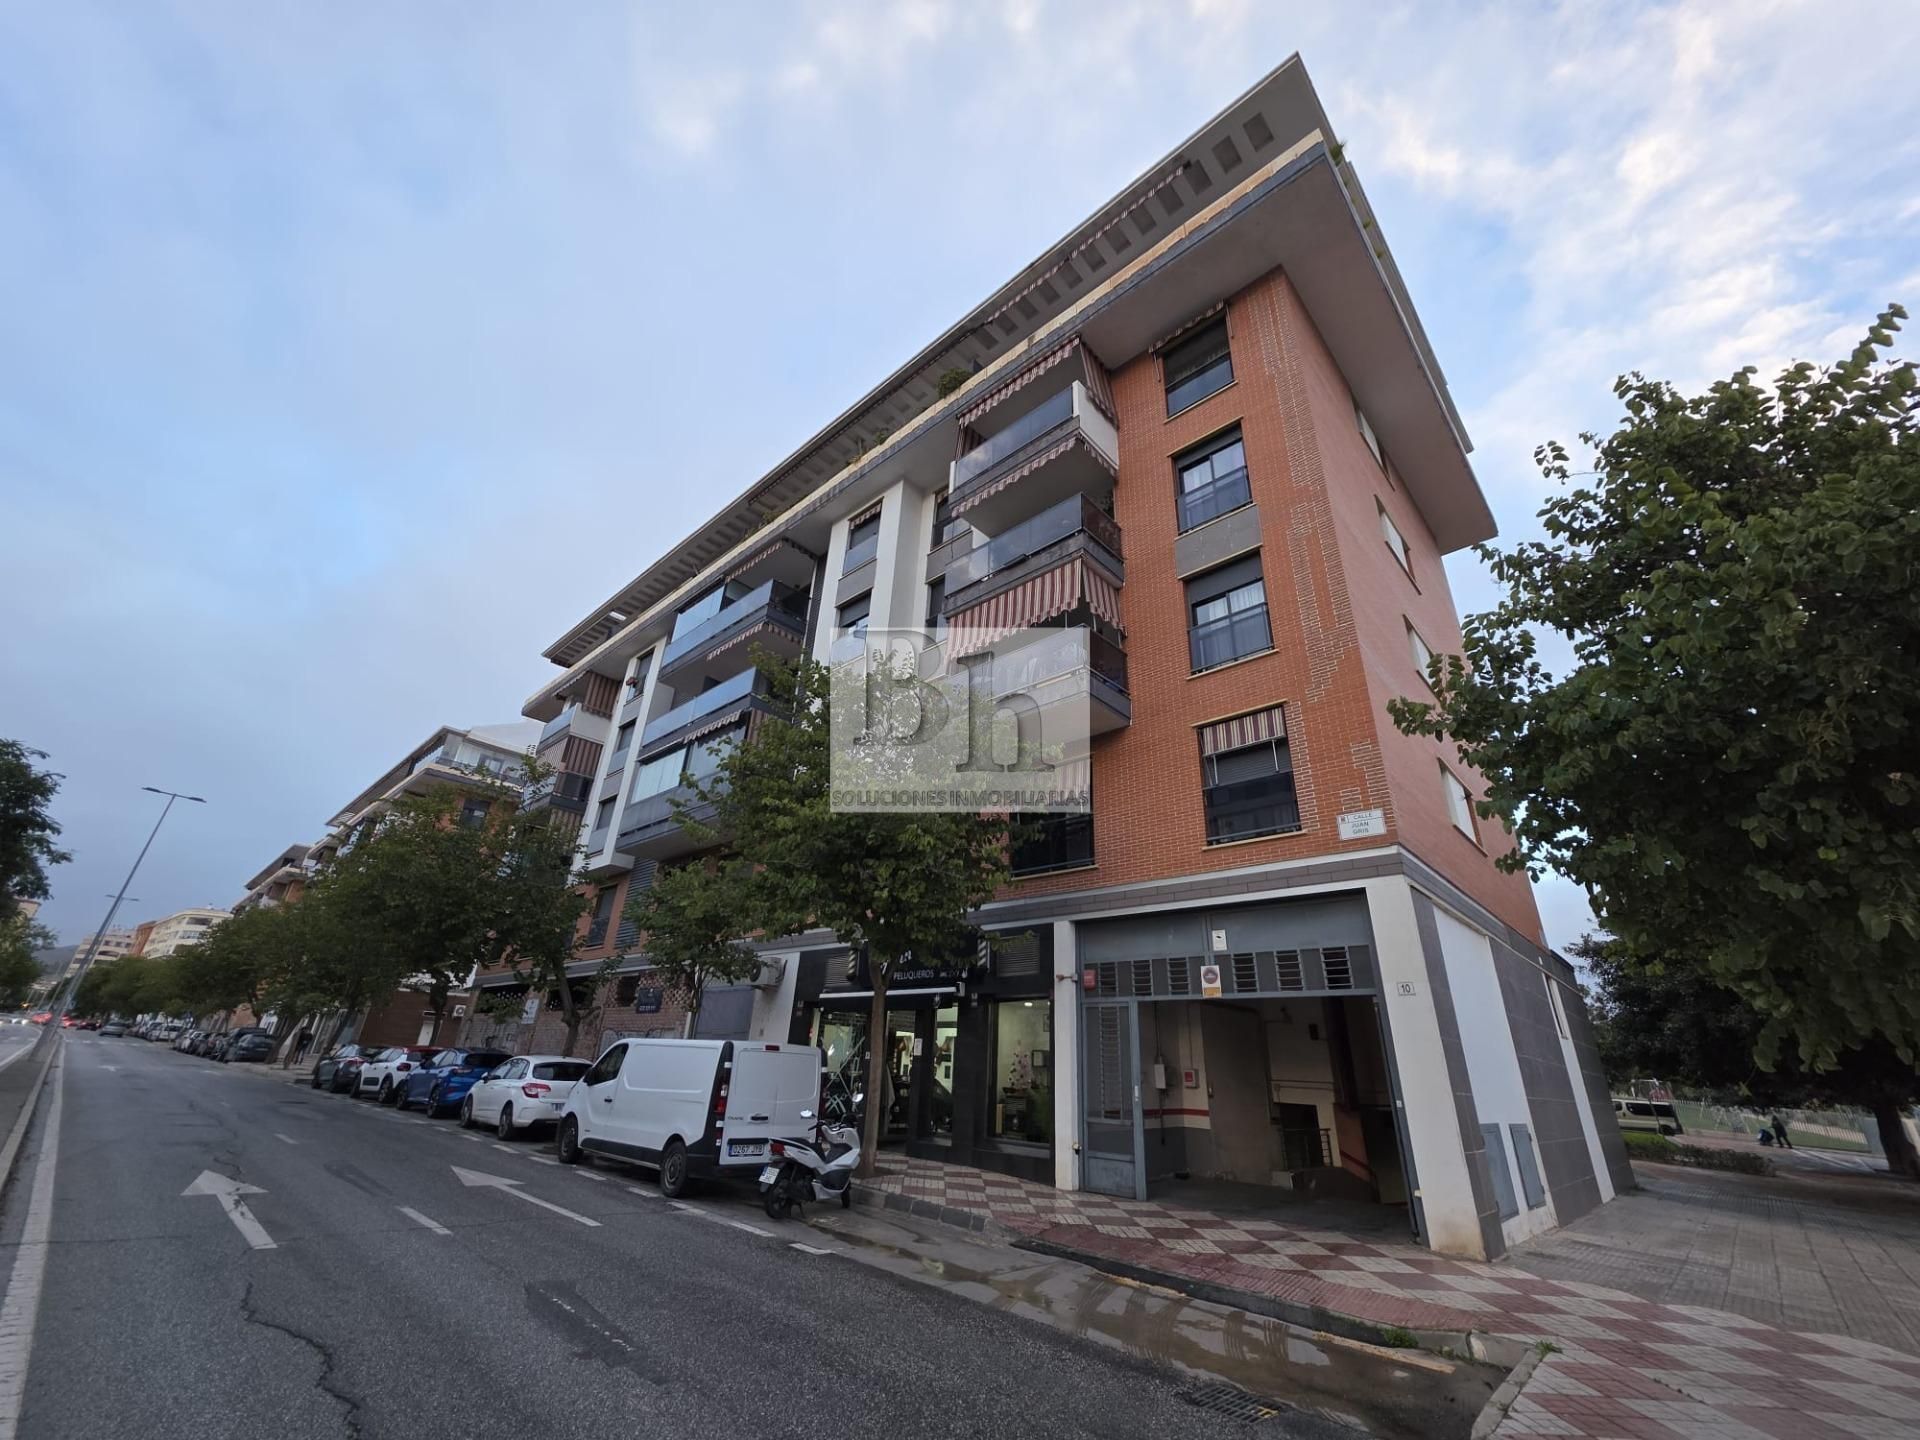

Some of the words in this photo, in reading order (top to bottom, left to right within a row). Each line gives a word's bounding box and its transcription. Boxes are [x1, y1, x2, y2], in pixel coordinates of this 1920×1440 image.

[1353, 812, 1372, 820] CALLE
[893, 970, 934, 981] PELUQUEROS
[1401, 983, 1411, 993] 10
